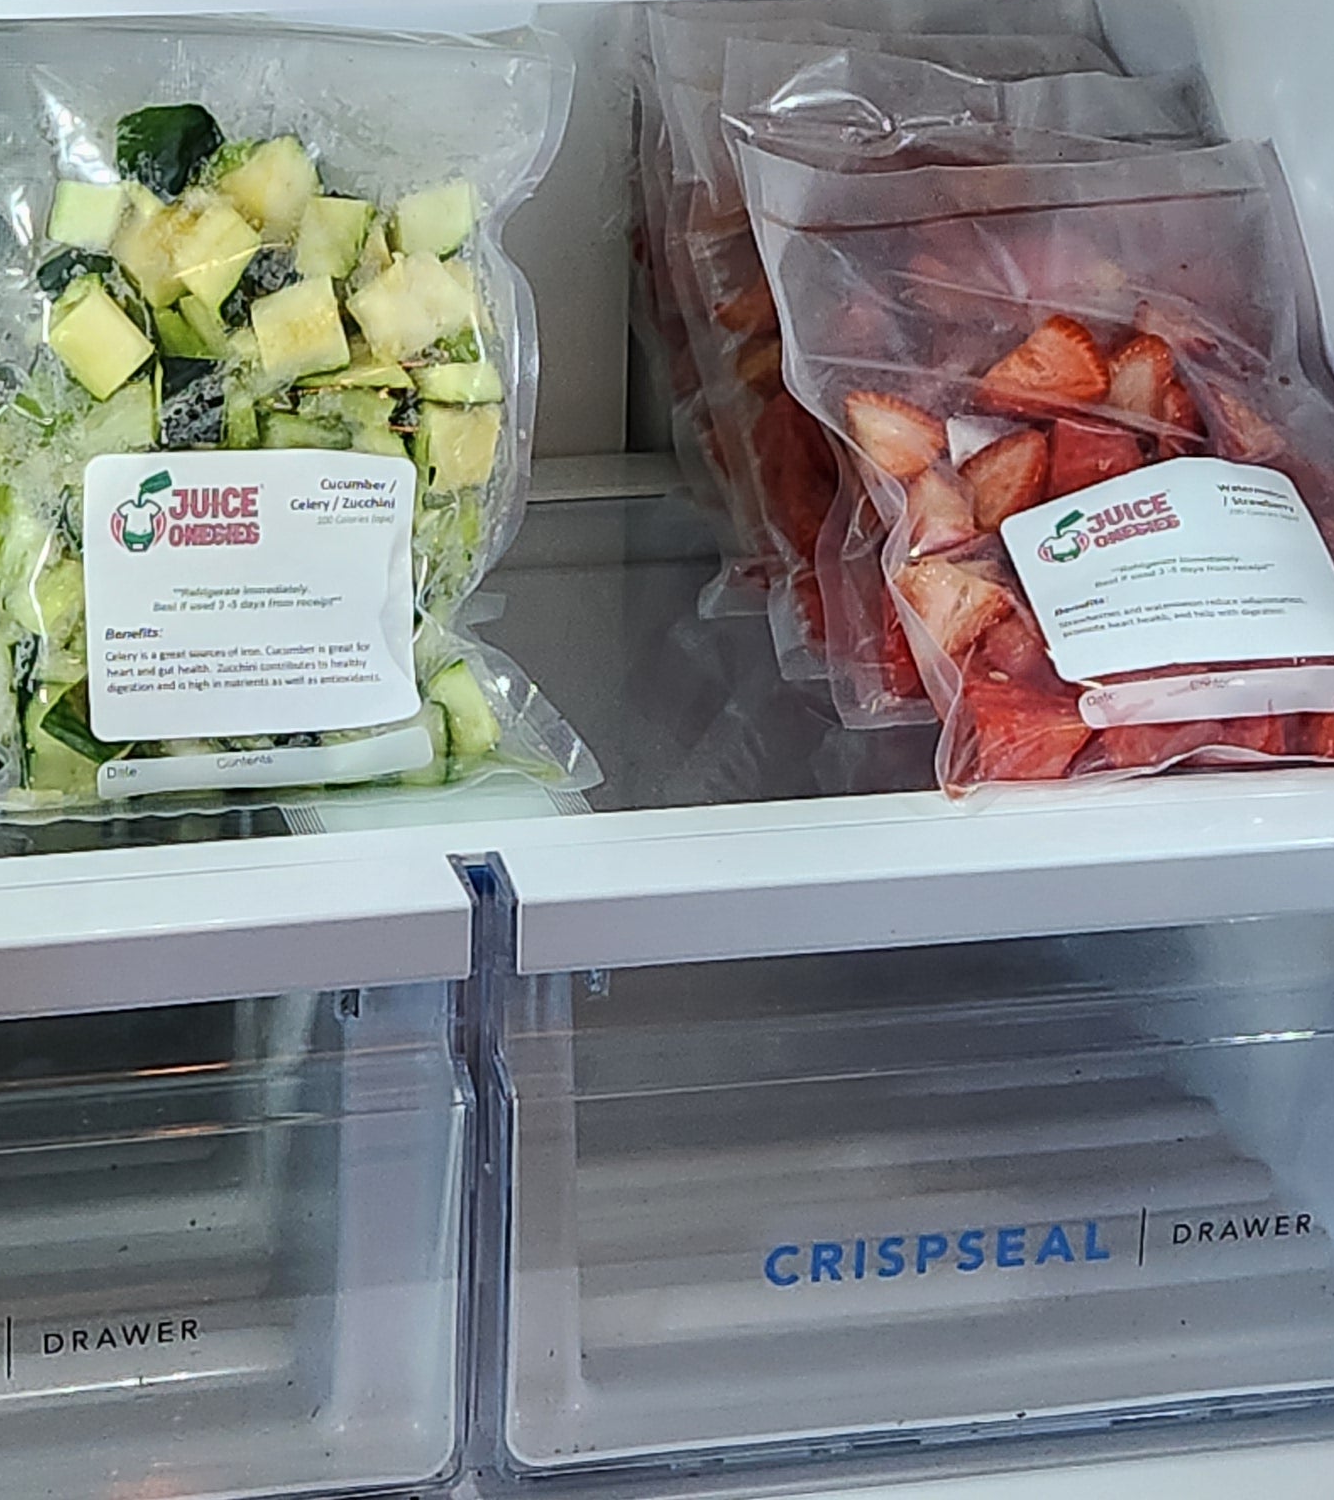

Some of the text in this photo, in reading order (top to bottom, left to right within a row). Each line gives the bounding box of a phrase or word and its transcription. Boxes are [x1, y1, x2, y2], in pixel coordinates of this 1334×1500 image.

[320, 478, 386, 490] Cucumber
[169, 487, 259, 520] JUICE
[290, 498, 328, 512] Celery
[343, 498, 395, 509] Zucchini
[1086, 491, 1173, 533] JUICE
[169, 523, 260, 547] ONESIES
[240, 600, 265, 611] days
[105, 628, 164, 640] Benefits:
[105, 651, 137, 662] Celery
[140, 651, 149, 660] is
[159, 650, 186, 661] great
[227, 648, 238, 658] of
[265, 645, 315, 656] Cucumber
[328, 643, 353, 655] great
[356, 642, 370, 651] for
[107, 667, 134, 677] heart
[137, 666, 156, 676] and
[159, 666, 175, 677] gut
[217, 662, 258, 673] Zucchini
[330, 659, 367, 670] healthy
[107, 682, 154, 694] digestion
[157, 681, 176, 690] and
[188, 679, 210, 691] high
[217, 754, 274, 769] Contents
[765, 1212, 1313, 1287] CRISPSEAL DRAWER
[42, 1318, 200, 1356] DRAWER
